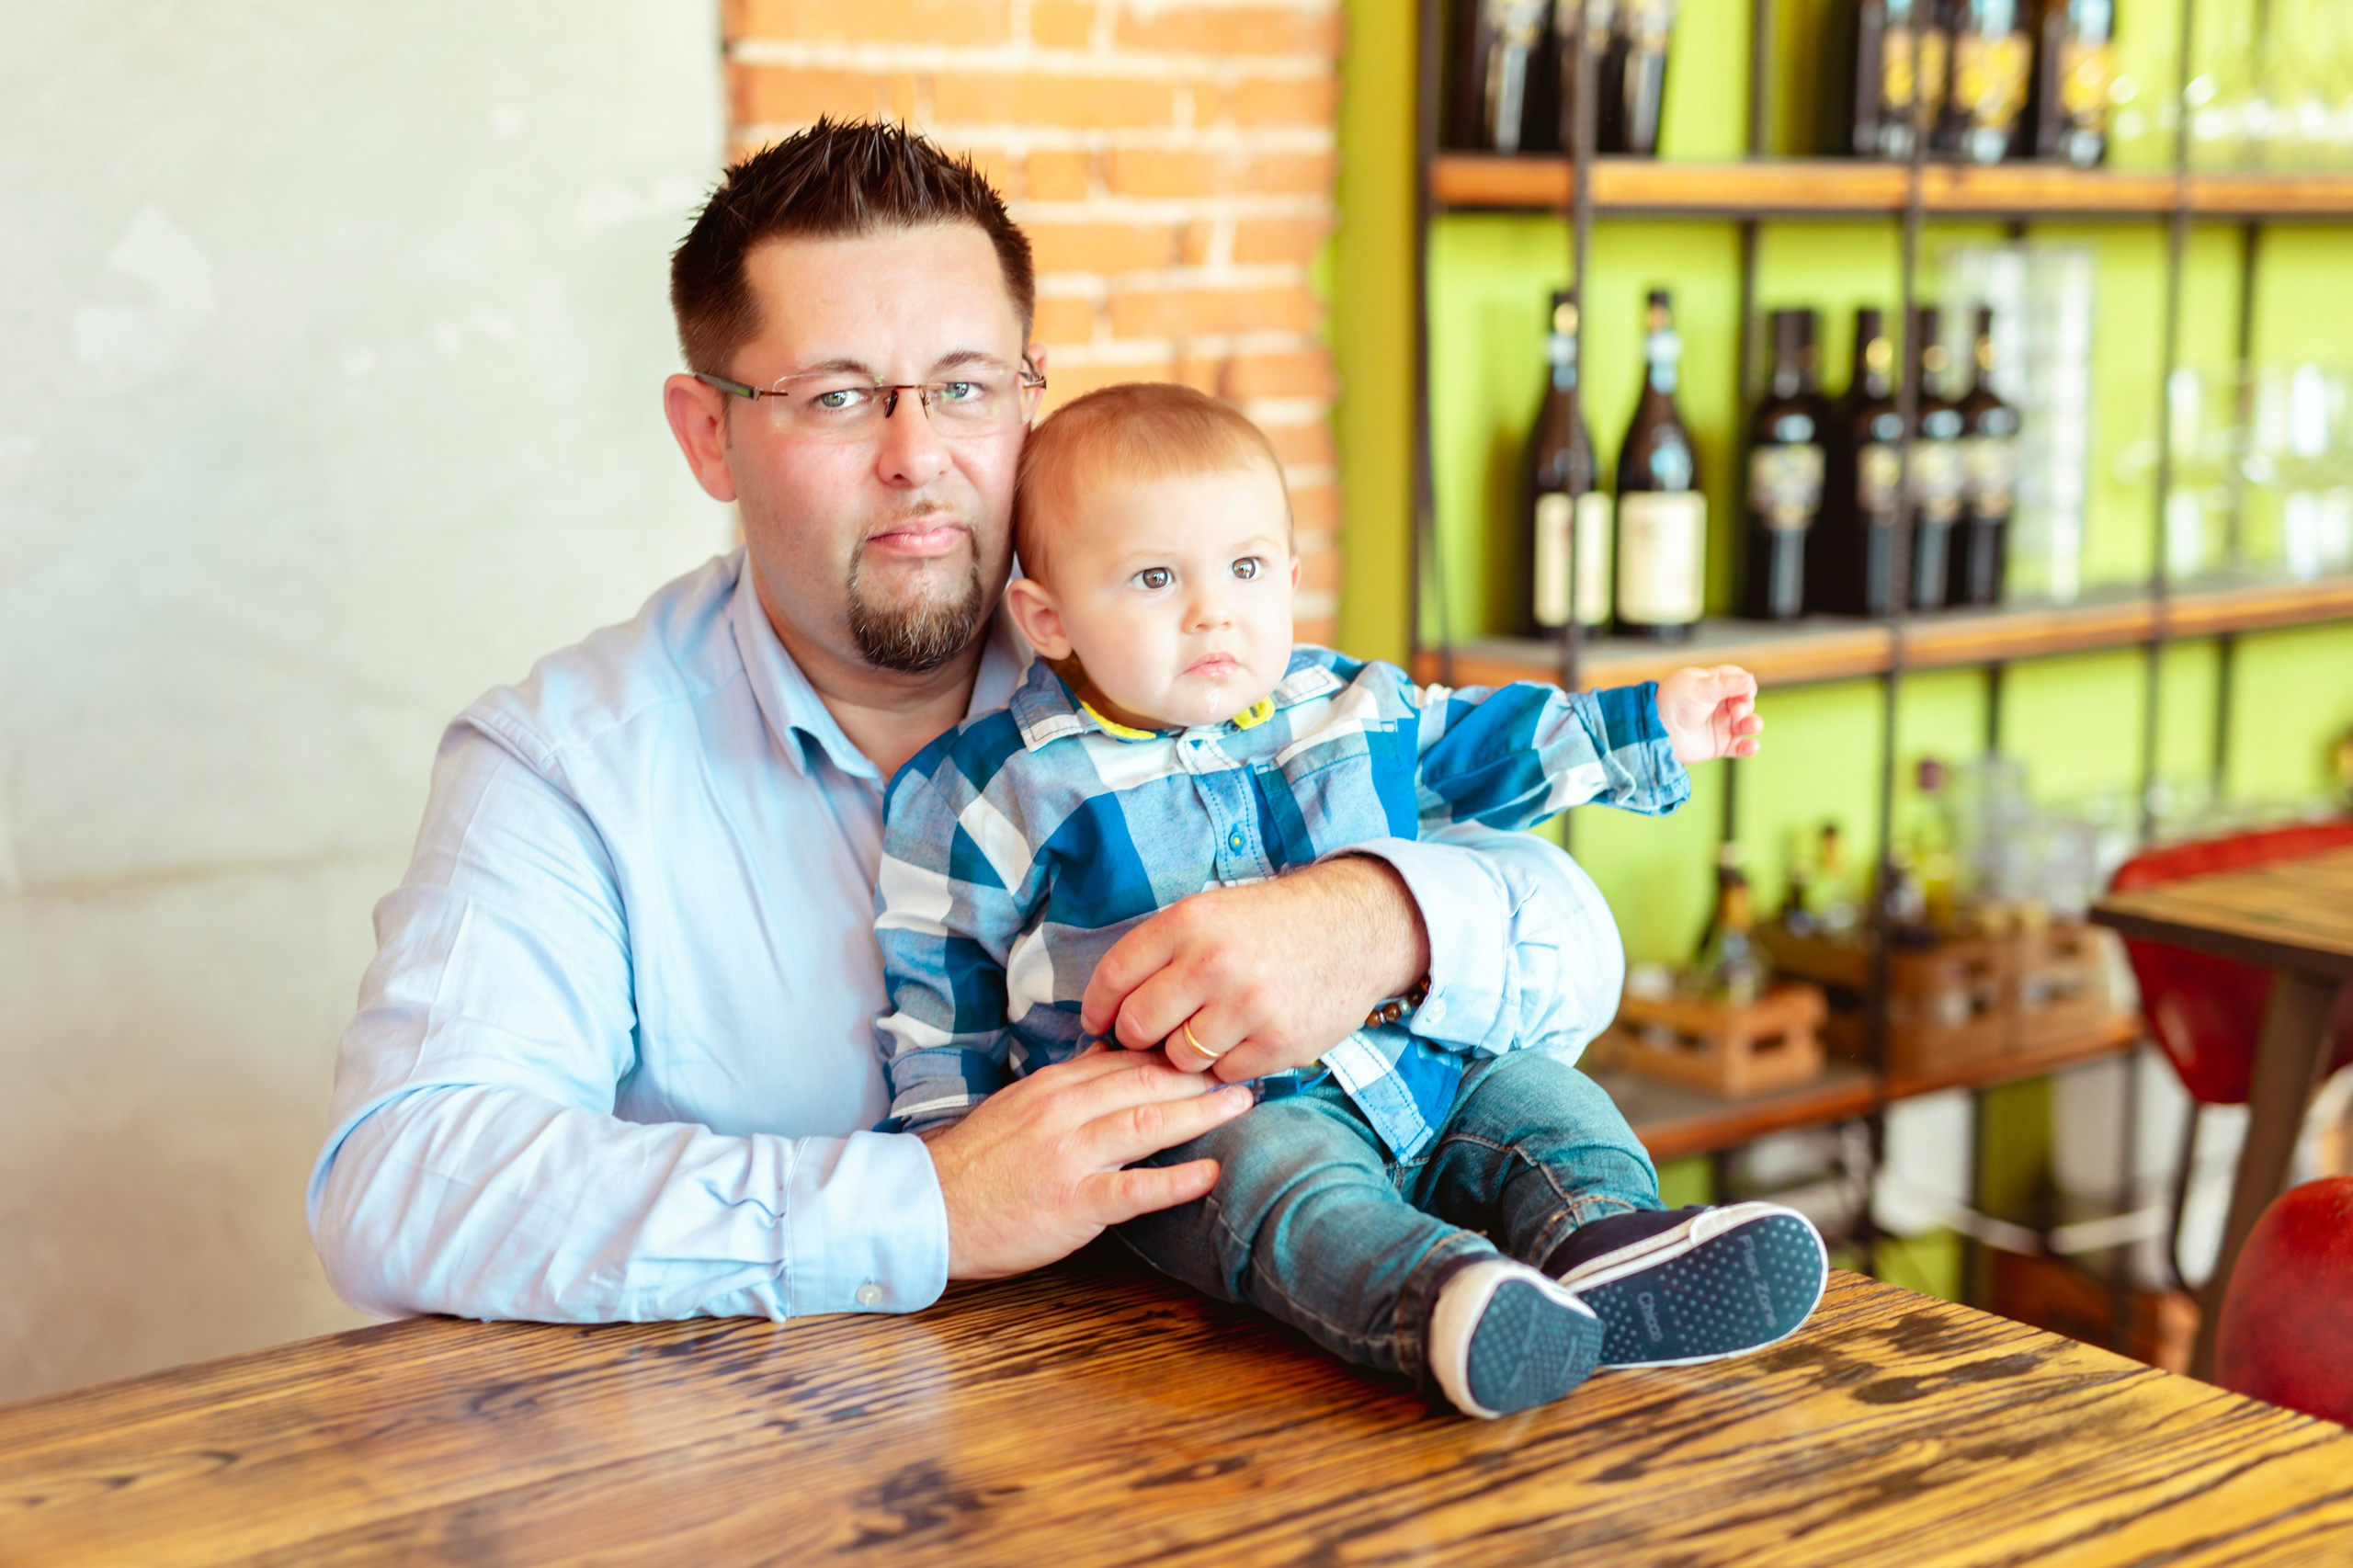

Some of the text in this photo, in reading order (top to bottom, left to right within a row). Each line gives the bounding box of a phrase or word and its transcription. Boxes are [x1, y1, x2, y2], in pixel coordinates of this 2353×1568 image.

[1638, 1291, 1663, 1342] Chicco
[1737, 1234, 1778, 1328] Flex Zone
